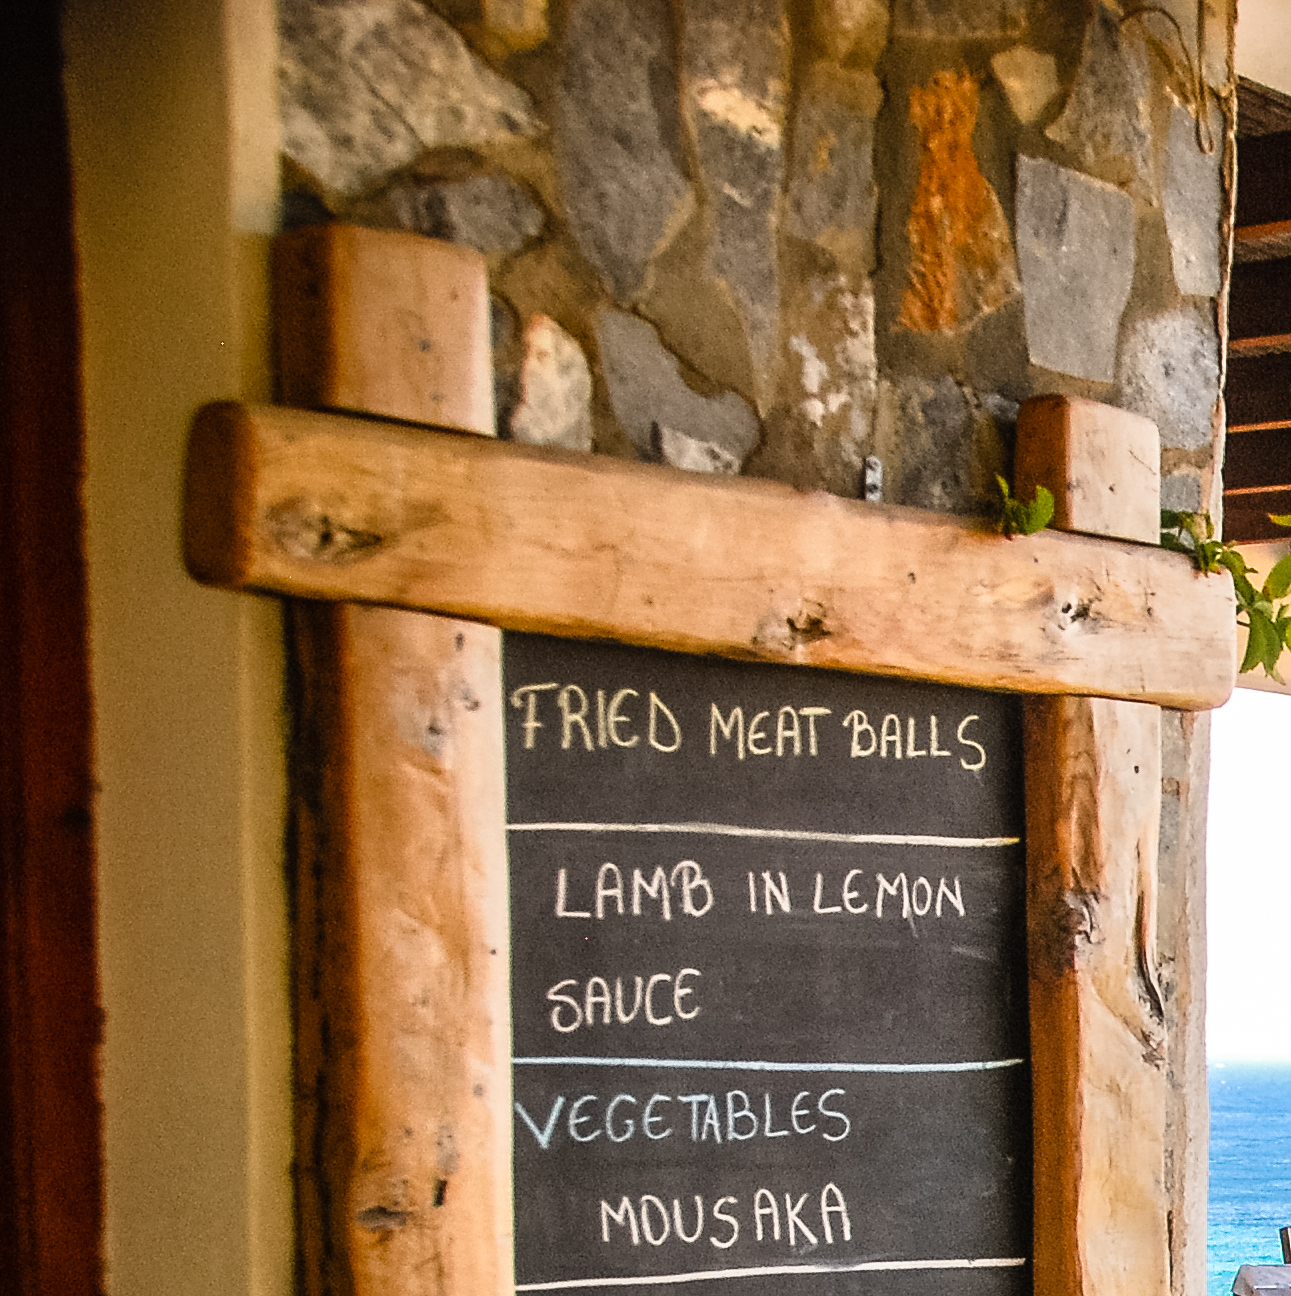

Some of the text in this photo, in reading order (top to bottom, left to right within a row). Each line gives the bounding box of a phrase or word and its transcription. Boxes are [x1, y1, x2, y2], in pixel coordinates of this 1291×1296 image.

[511, 682, 986, 771] FRIED MEAT BALLS
[555, 860, 966, 921] LAMB IN LEMON
[548, 968, 702, 1033] SAUCE
[514, 1088, 851, 1149] VEGETABLES
[600, 1182, 852, 1249] MOUSAKA
